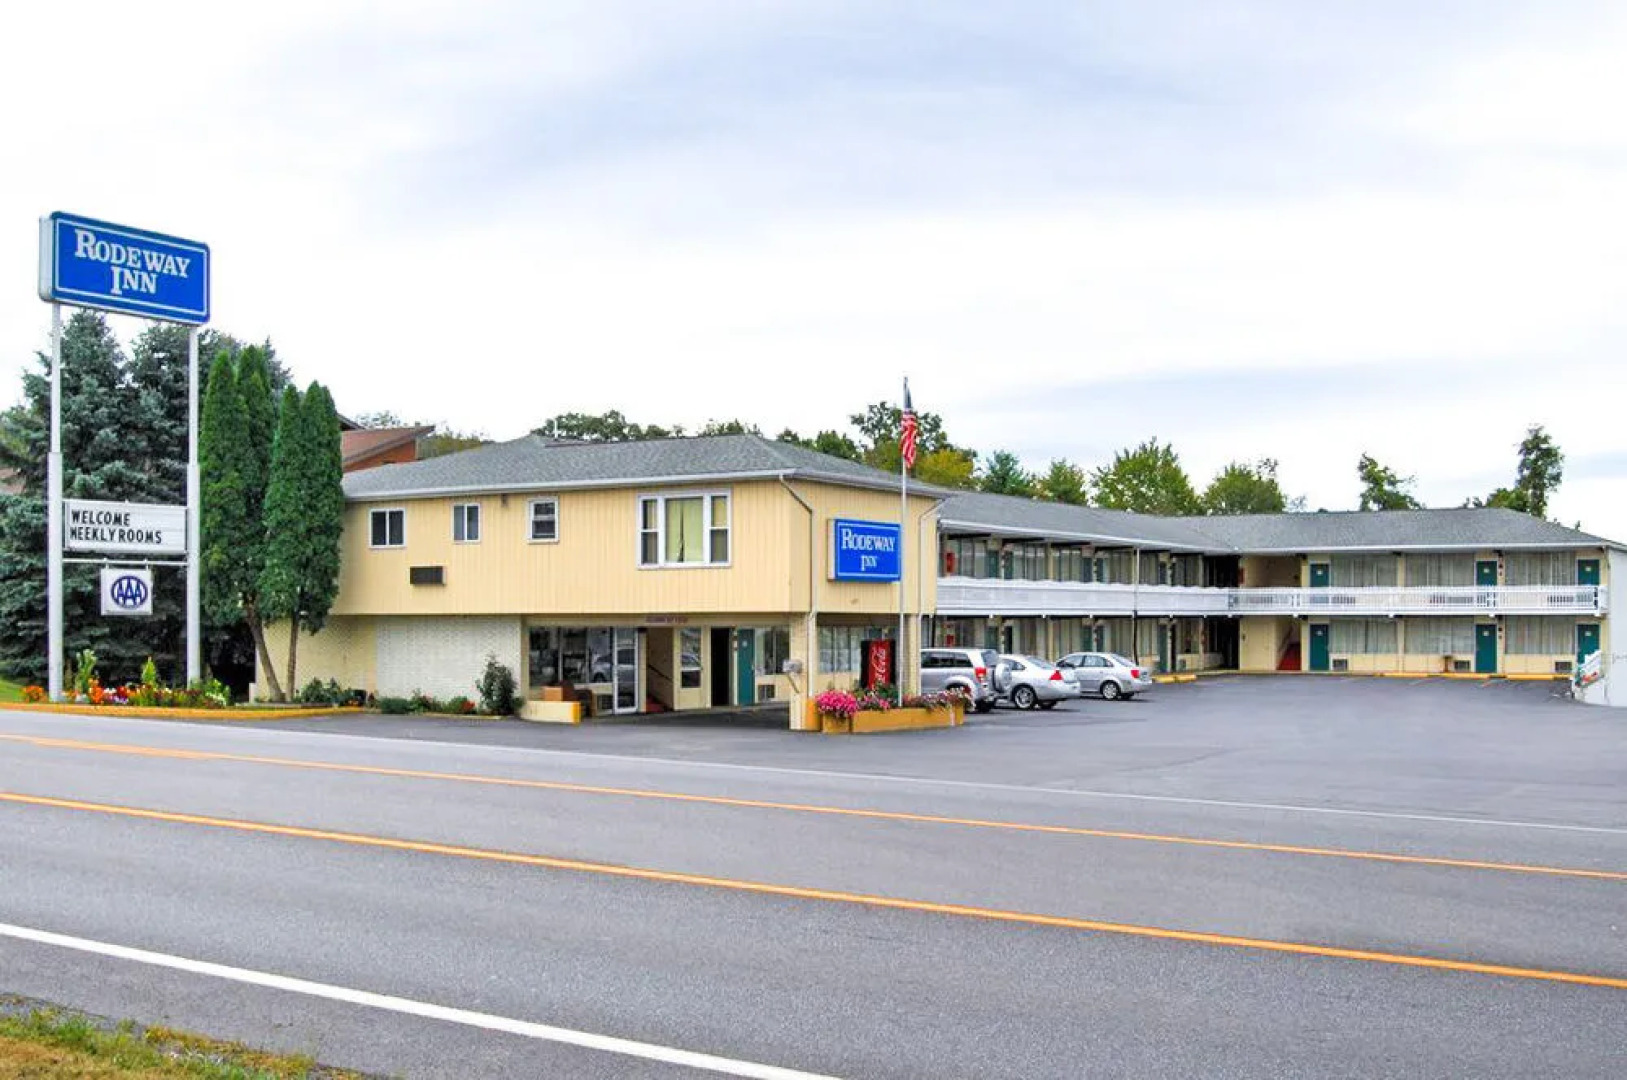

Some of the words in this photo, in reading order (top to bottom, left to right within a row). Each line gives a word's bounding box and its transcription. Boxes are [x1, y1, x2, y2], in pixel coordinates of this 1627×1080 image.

[74, 228, 191, 278] RODEWAY
[110, 266, 157, 295] INN
[71, 510, 131, 526] WELCOME
[115, 577, 144, 606] AAA
